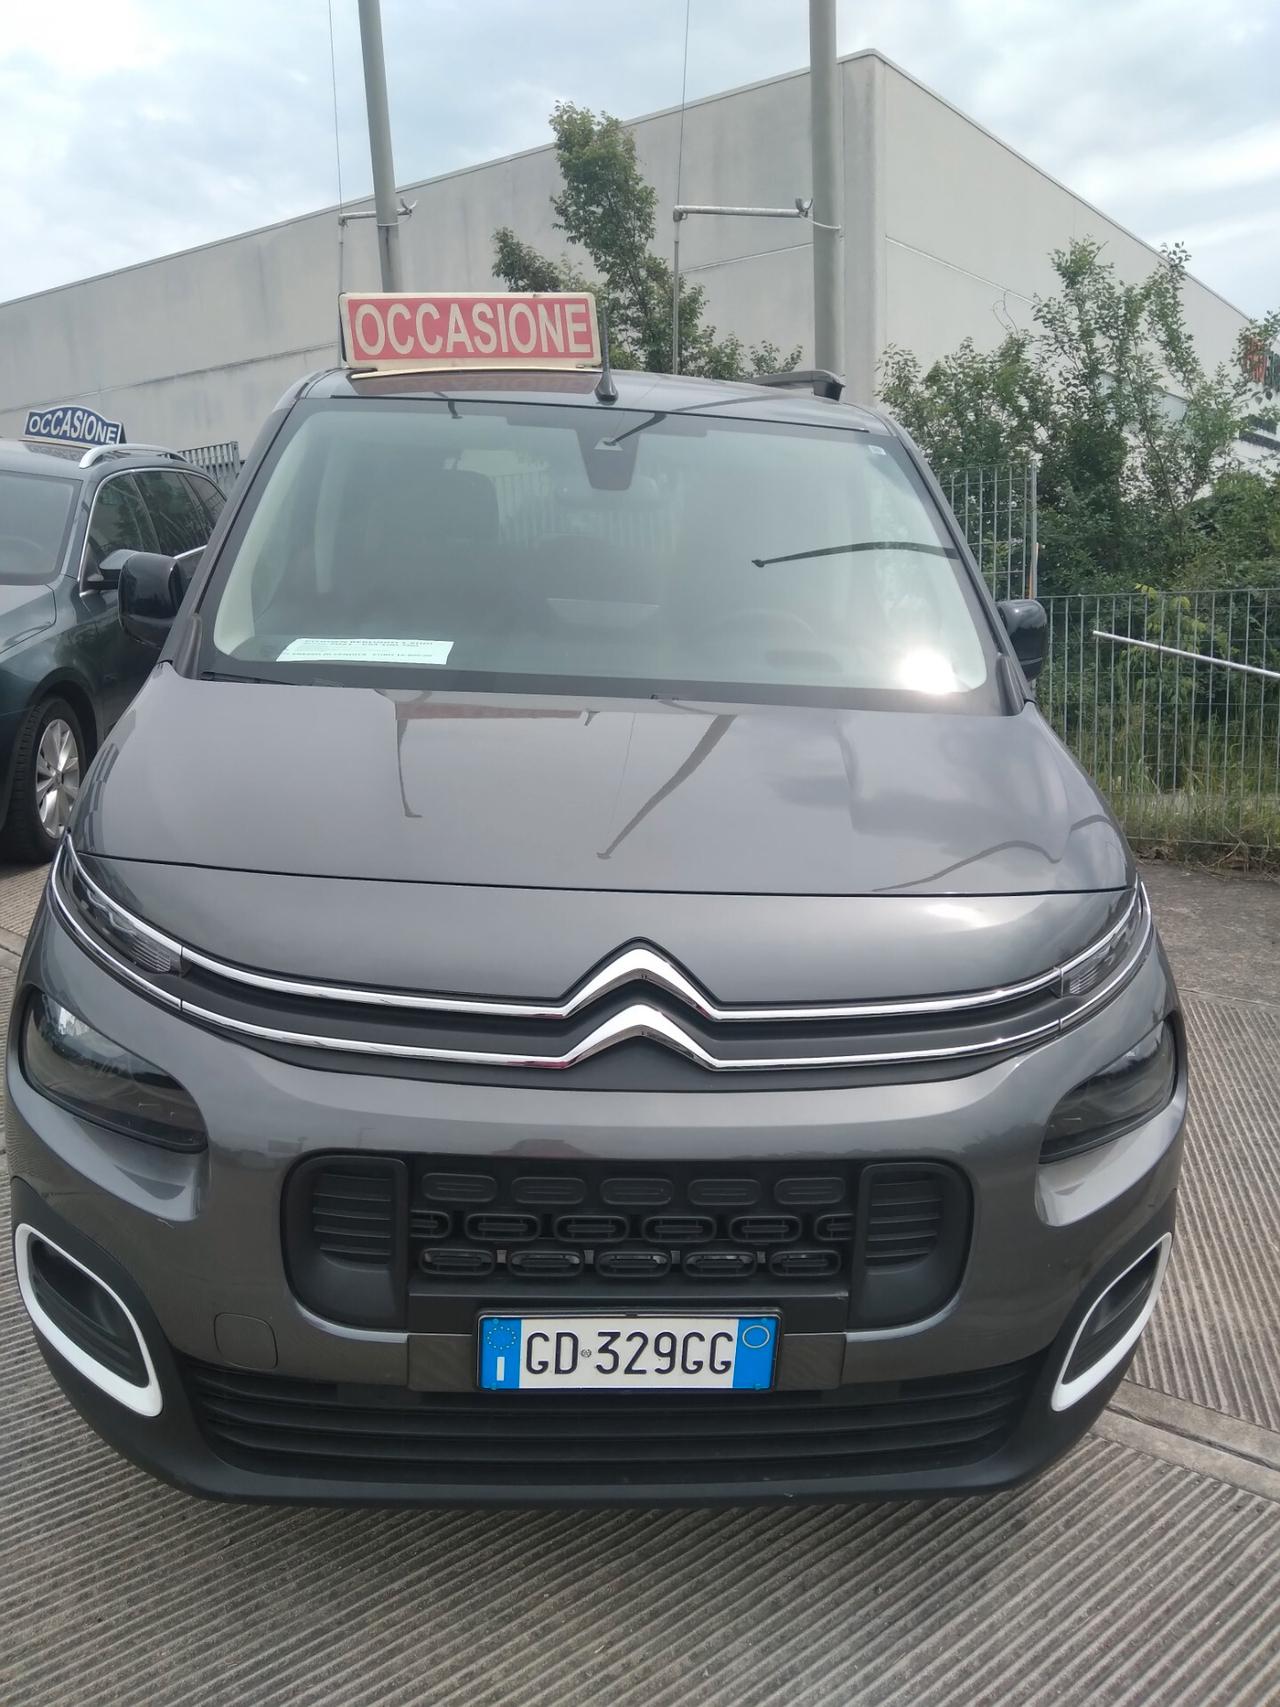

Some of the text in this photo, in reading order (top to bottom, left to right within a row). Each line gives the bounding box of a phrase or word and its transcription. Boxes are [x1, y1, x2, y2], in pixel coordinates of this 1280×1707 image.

[355, 303, 591, 355] OCCASIONE
[29, 410, 118, 444] OCCASIONE
[526, 1332, 579, 1375] GD
[595, 1331, 734, 1375] 329GG
